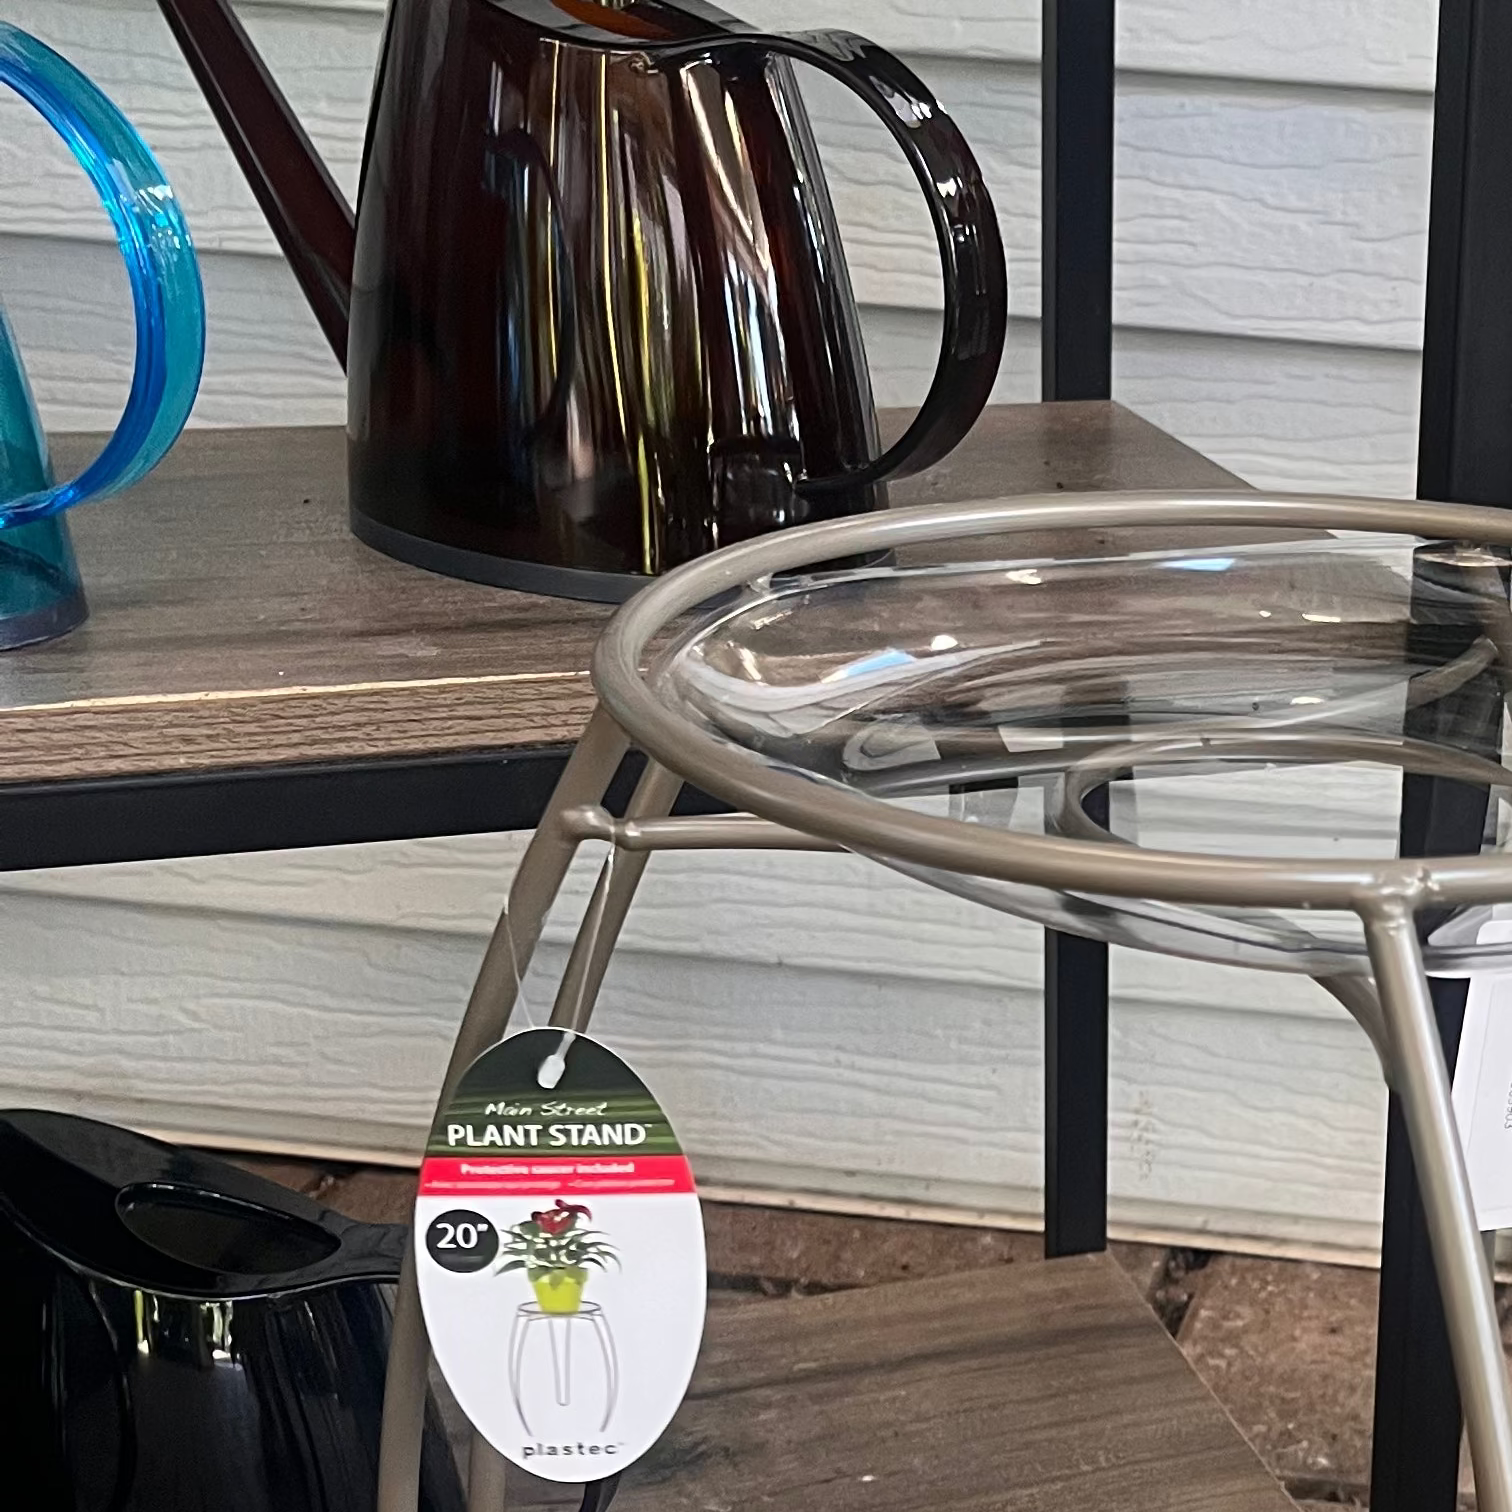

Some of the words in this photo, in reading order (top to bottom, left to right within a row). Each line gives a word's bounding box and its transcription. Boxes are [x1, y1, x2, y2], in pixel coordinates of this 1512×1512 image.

[484, 1101, 533, 1117] Main
[539, 1100, 608, 1117] Street
[447, 1123, 543, 1147] PLANT
[549, 1122, 647, 1147] STAND
[435, 1222, 489, 1249] 20"
[521, 1442, 618, 1460] plastec
